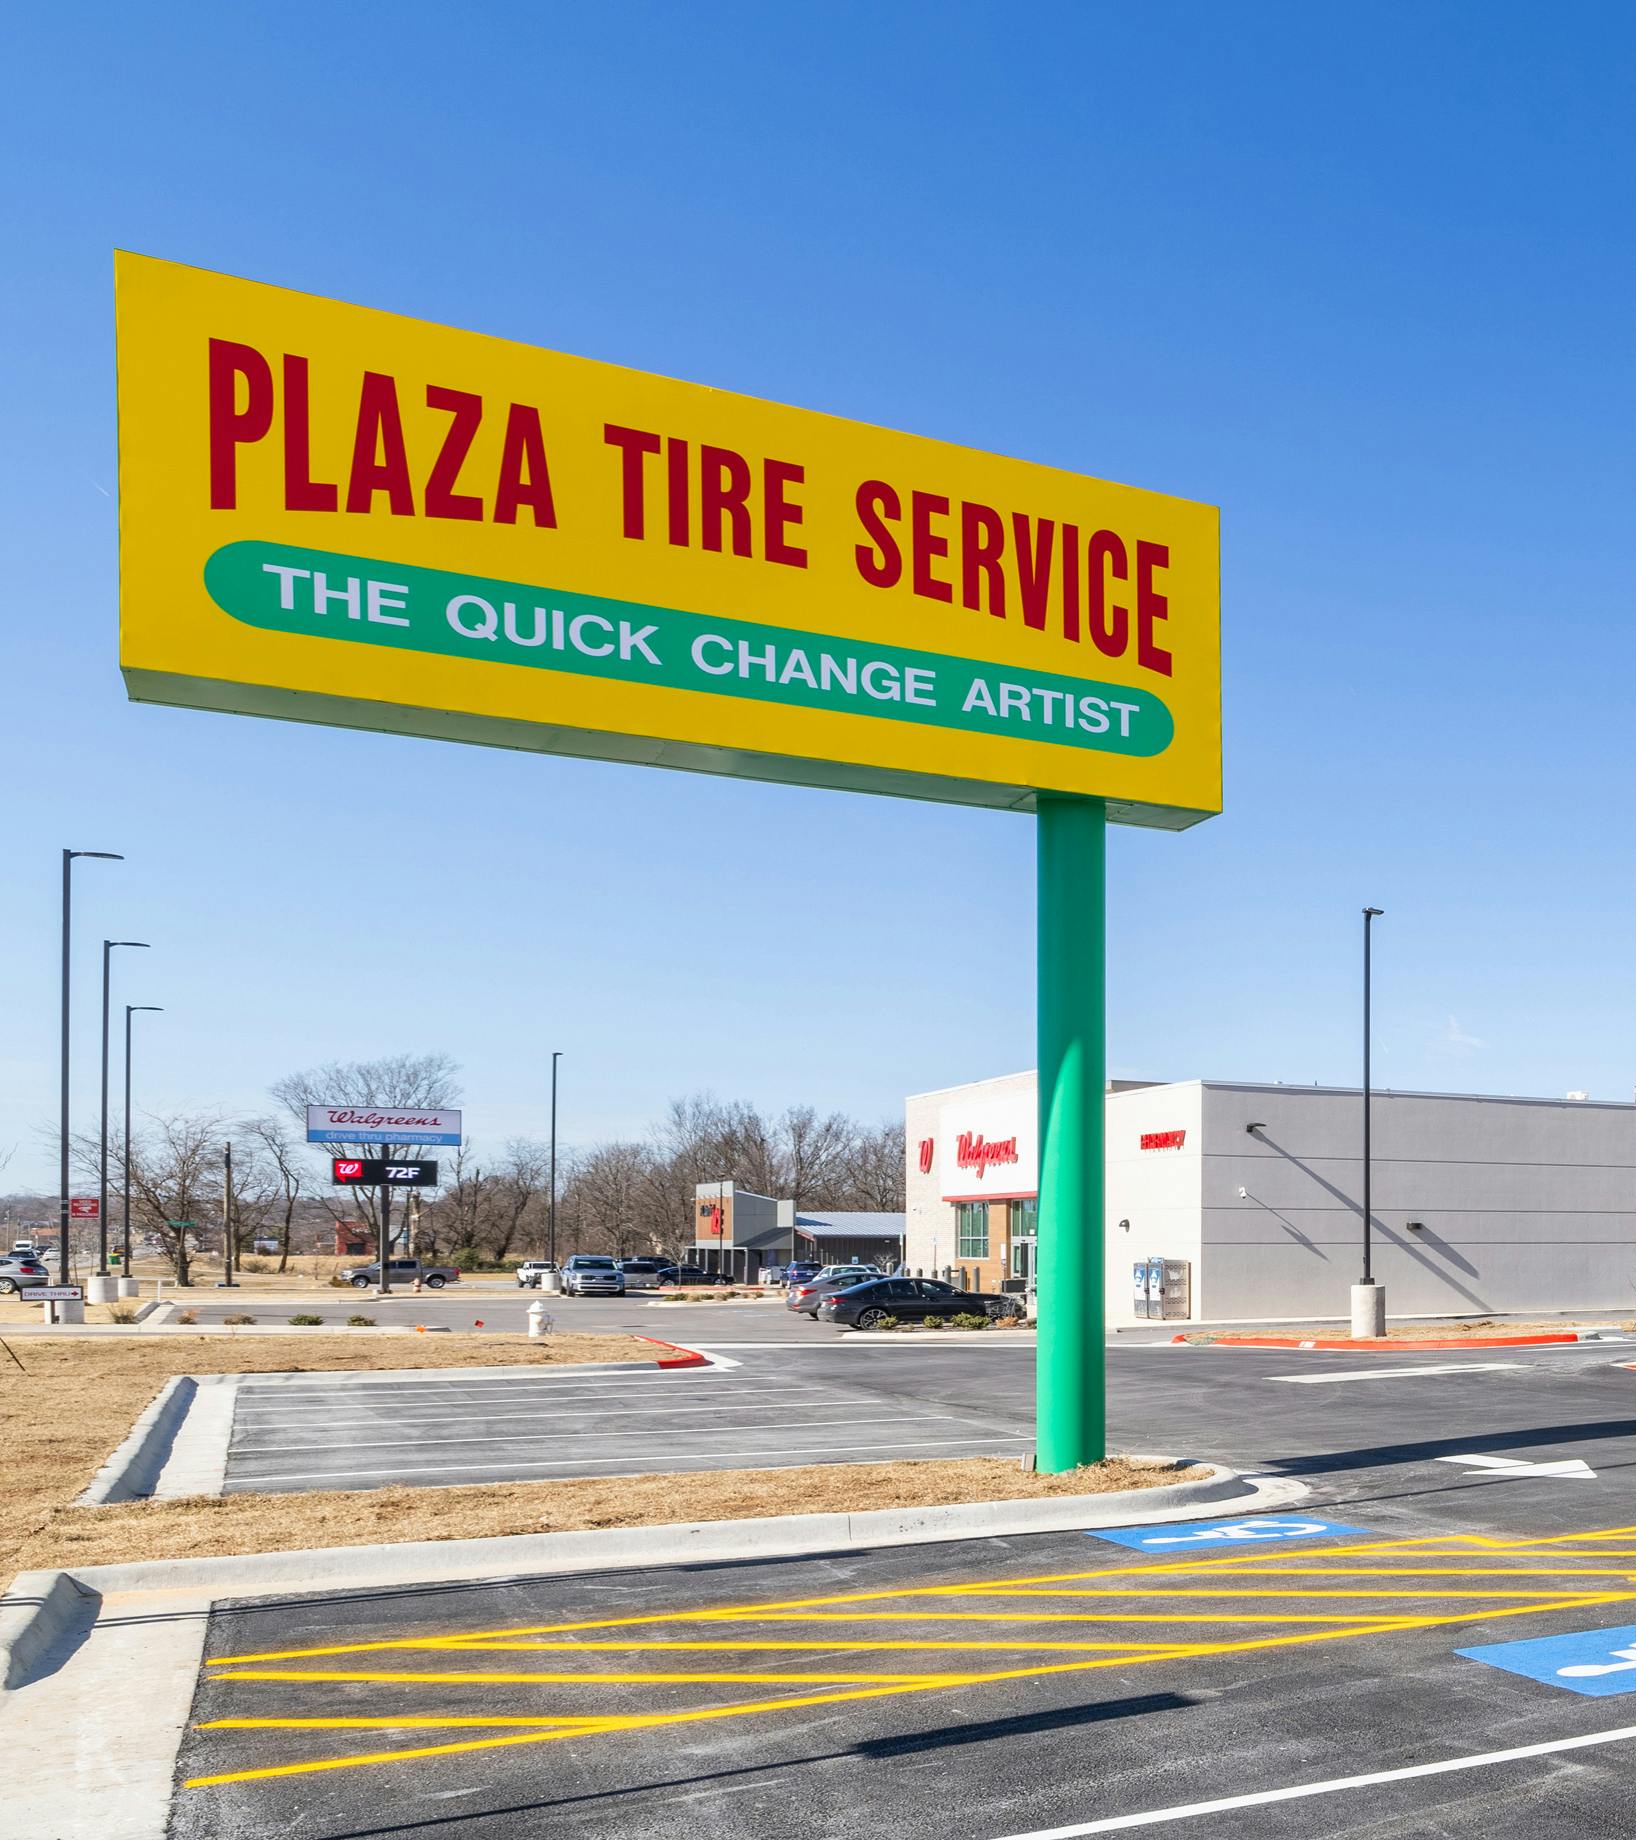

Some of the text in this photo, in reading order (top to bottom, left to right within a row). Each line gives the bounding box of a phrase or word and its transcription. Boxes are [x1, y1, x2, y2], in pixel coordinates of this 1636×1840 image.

[208, 337, 1173, 678] PLAZA TIRE SERVICE
[262, 563, 1141, 738] THE QUICK CHANGE ARTIST
[327, 1110, 443, 1129] Walgreens
[325, 1131, 443, 1143] drive thru pharmacy
[385, 1167, 421, 1179] 72F
